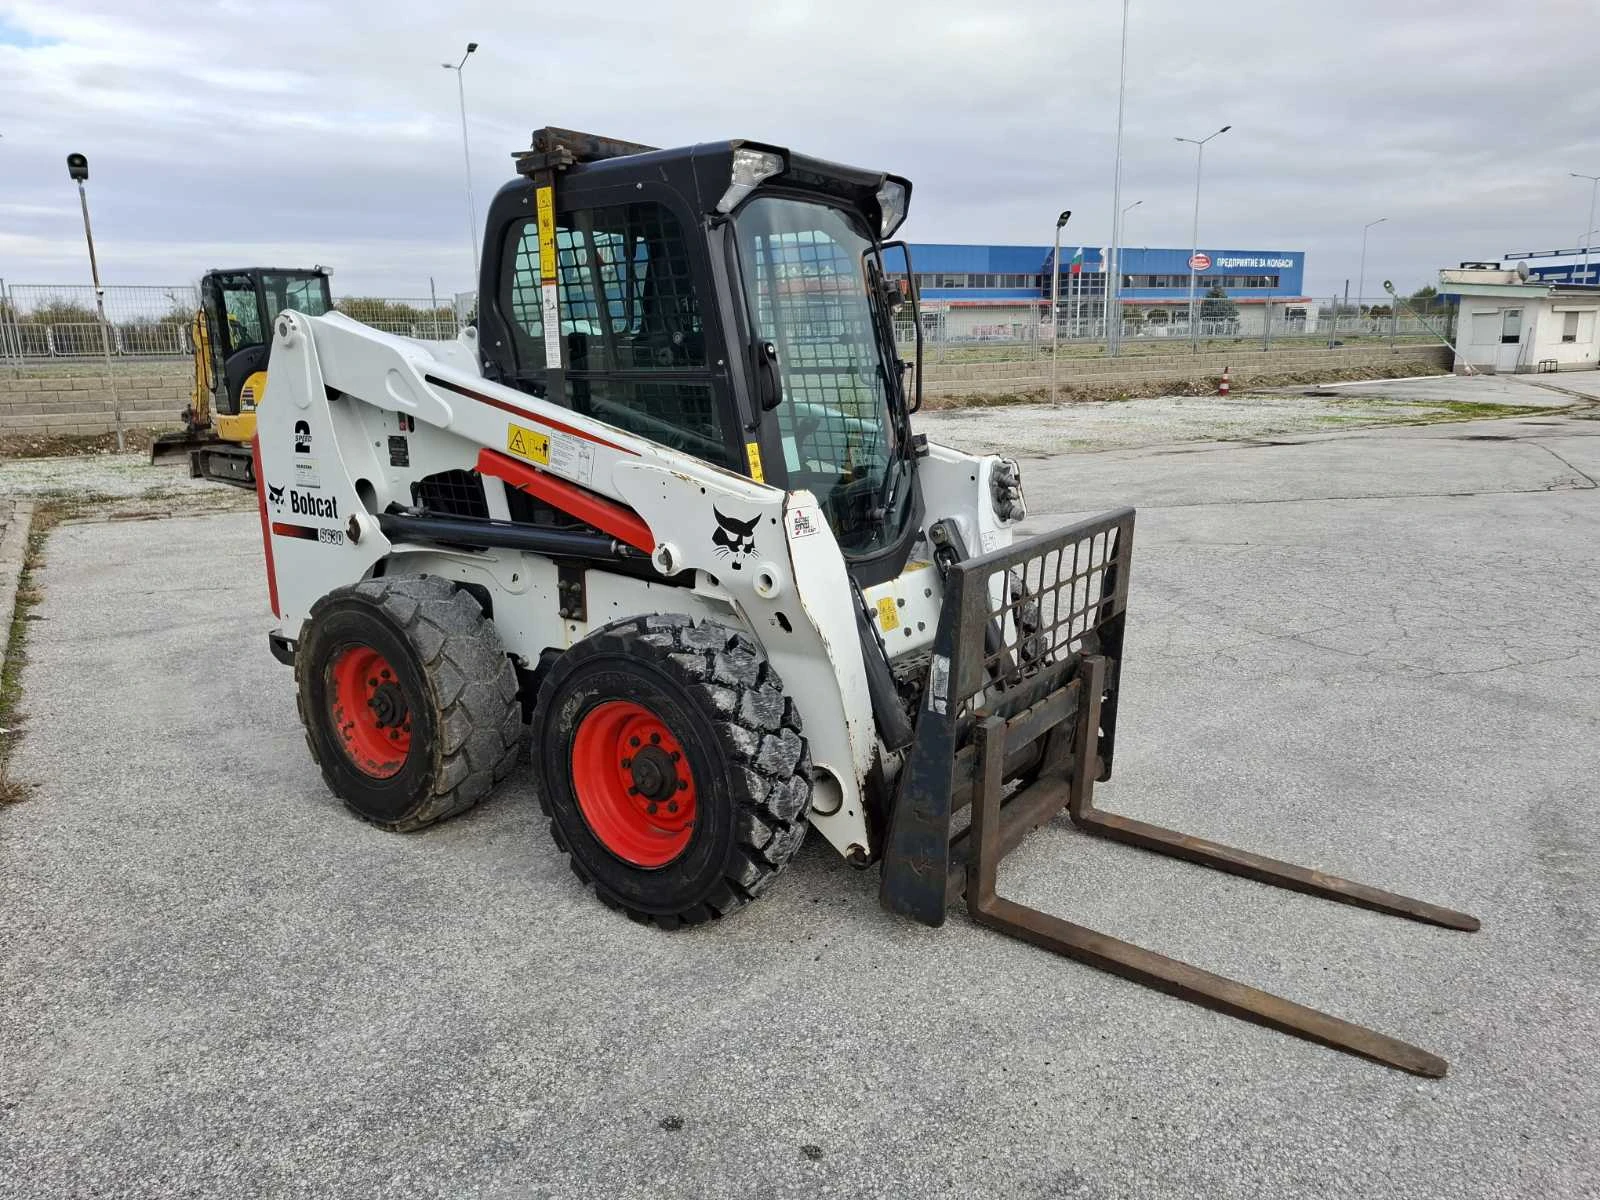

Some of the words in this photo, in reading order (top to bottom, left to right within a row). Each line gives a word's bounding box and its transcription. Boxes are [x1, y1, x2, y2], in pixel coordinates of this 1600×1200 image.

[1259, 258, 1266, 268] ЗА
[295, 420, 310, 453] 2
[295, 434, 312, 442] SPEED
[290, 490, 338, 519] Bobcat
[320, 528, 343, 545] S630
